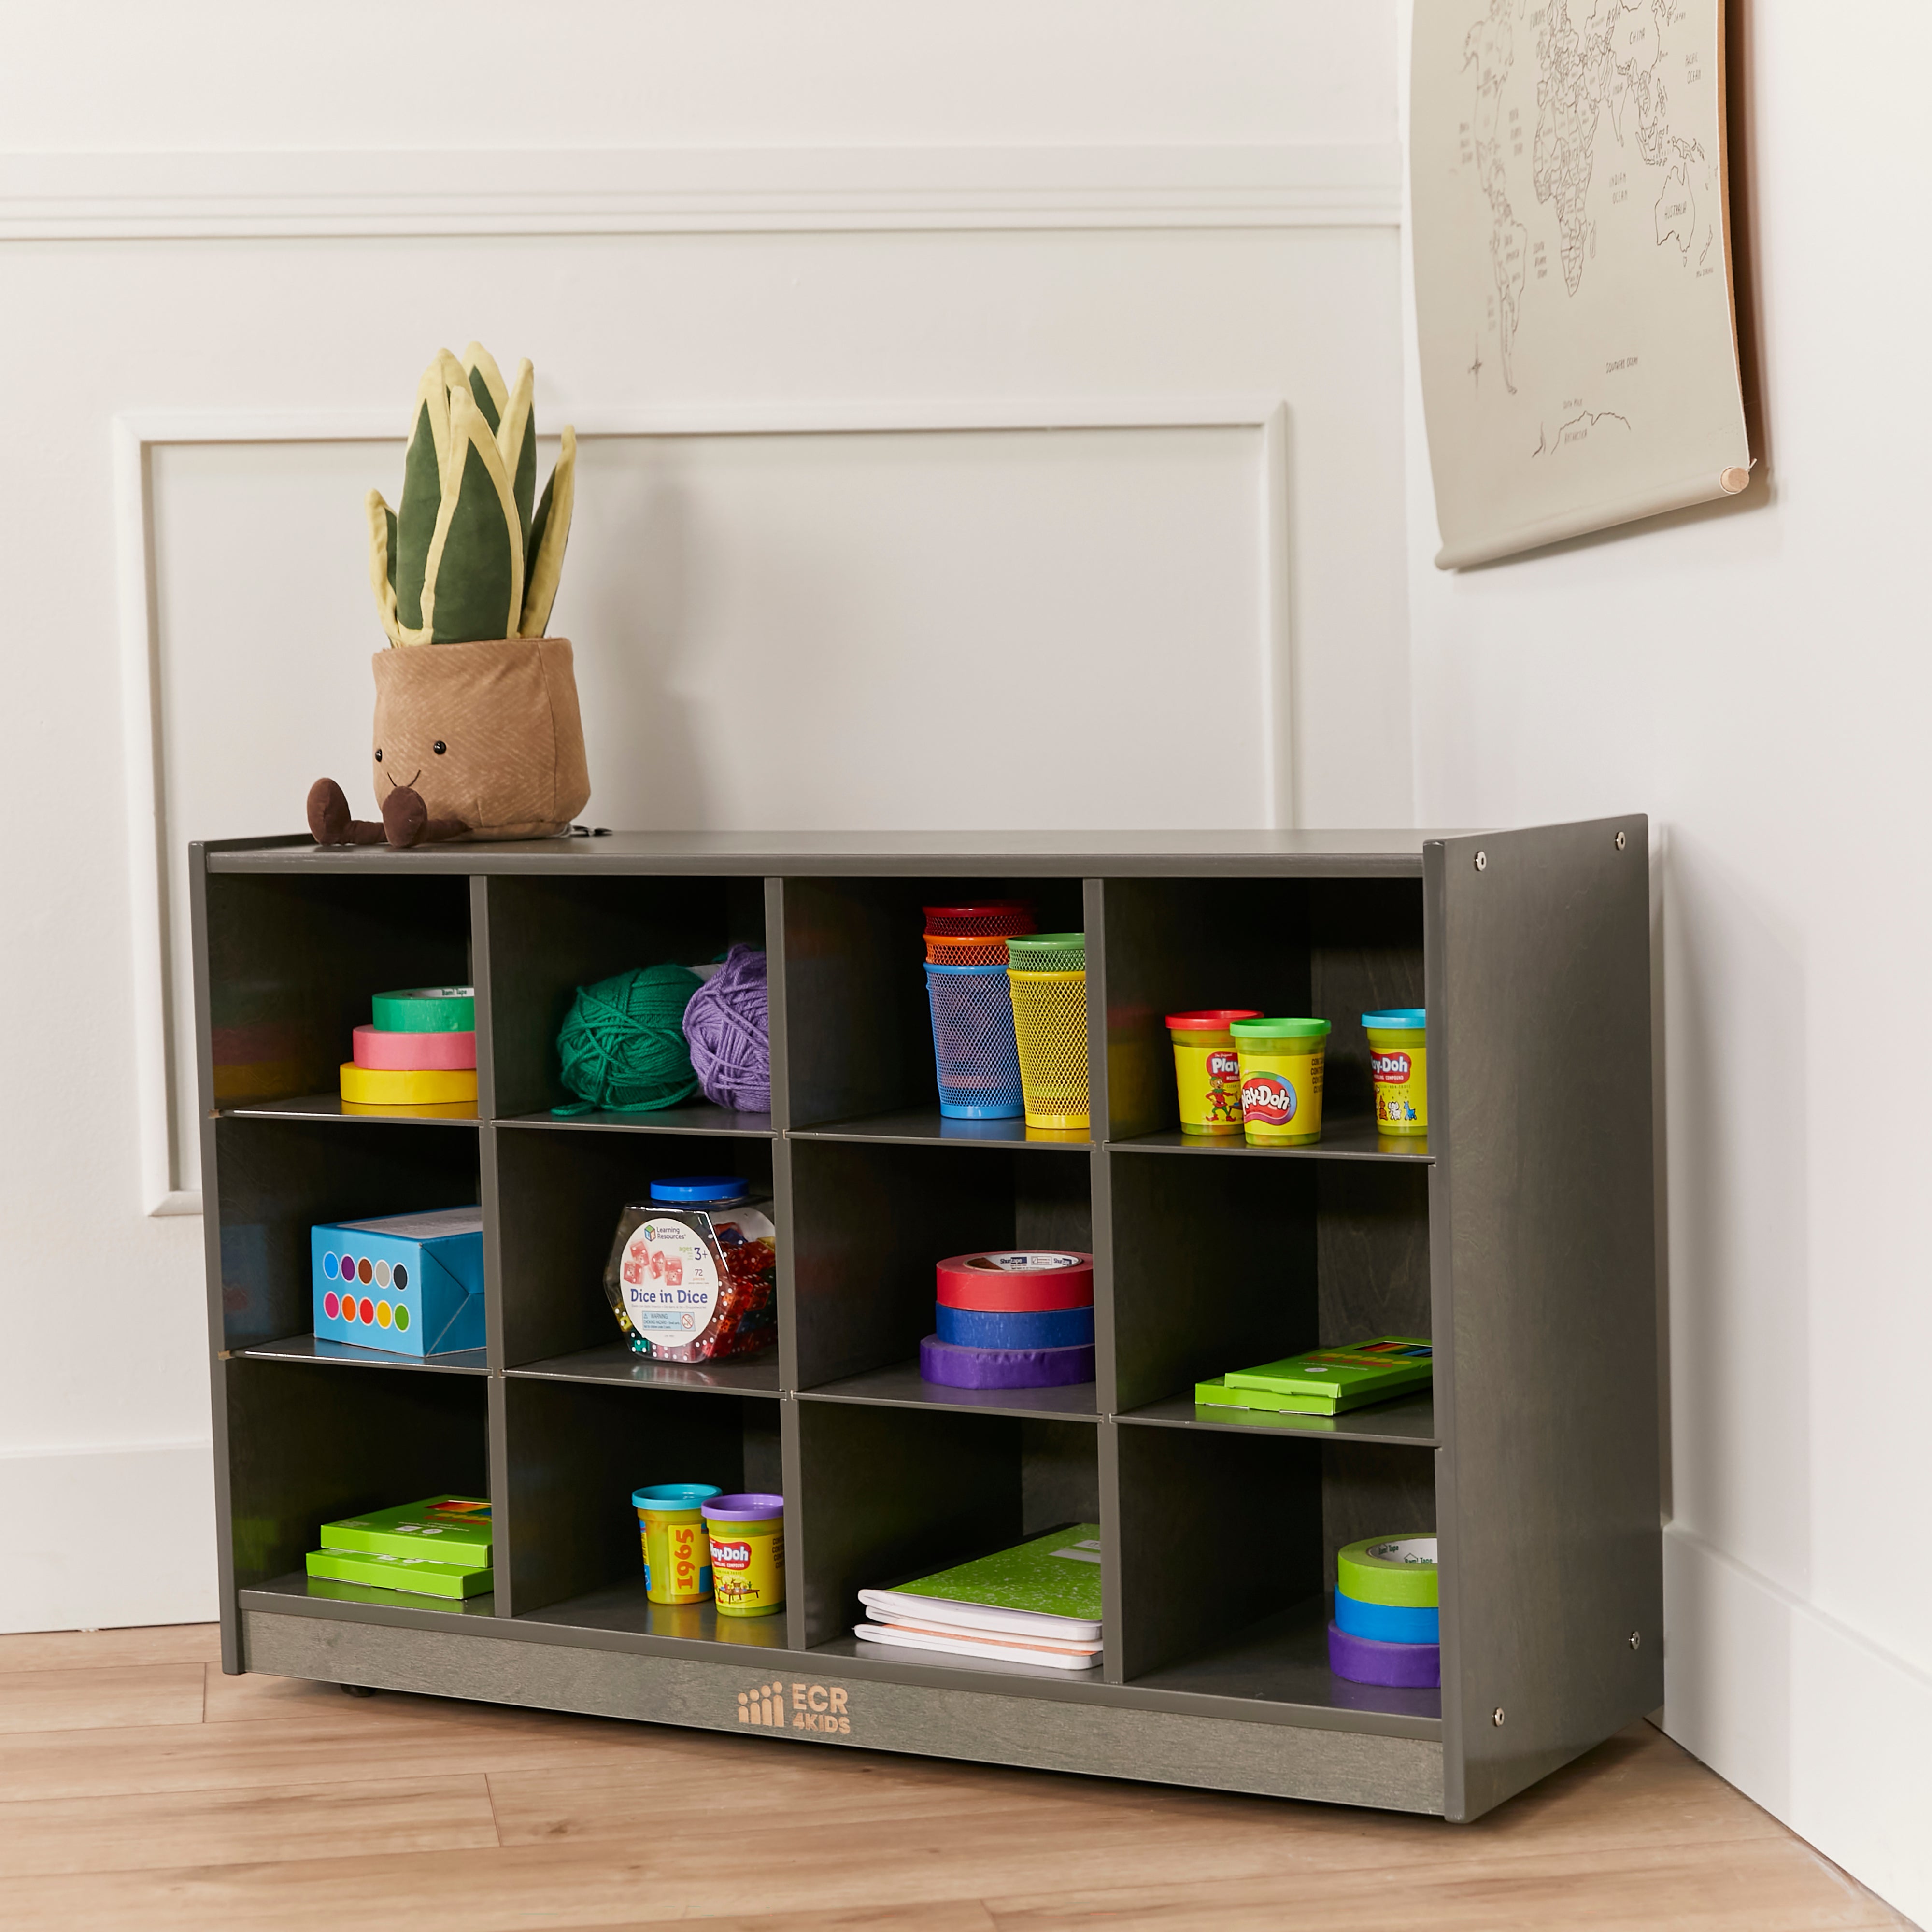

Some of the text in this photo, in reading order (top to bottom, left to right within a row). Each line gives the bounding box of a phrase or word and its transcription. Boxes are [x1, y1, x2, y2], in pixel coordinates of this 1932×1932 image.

[1630, 28, 1645, 45] CHINA
[1687, 69, 1701, 84] OCEAN
[694, 1247, 708, 1261] 3+
[631, 1288, 708, 1304] Dice in Dice
[1388, 1545, 1399, 1553] Tape
[674, 1528, 696, 1589] 1965
[792, 1683, 848, 1714] ECR
[792, 1712, 851, 1734] 4KIDS
